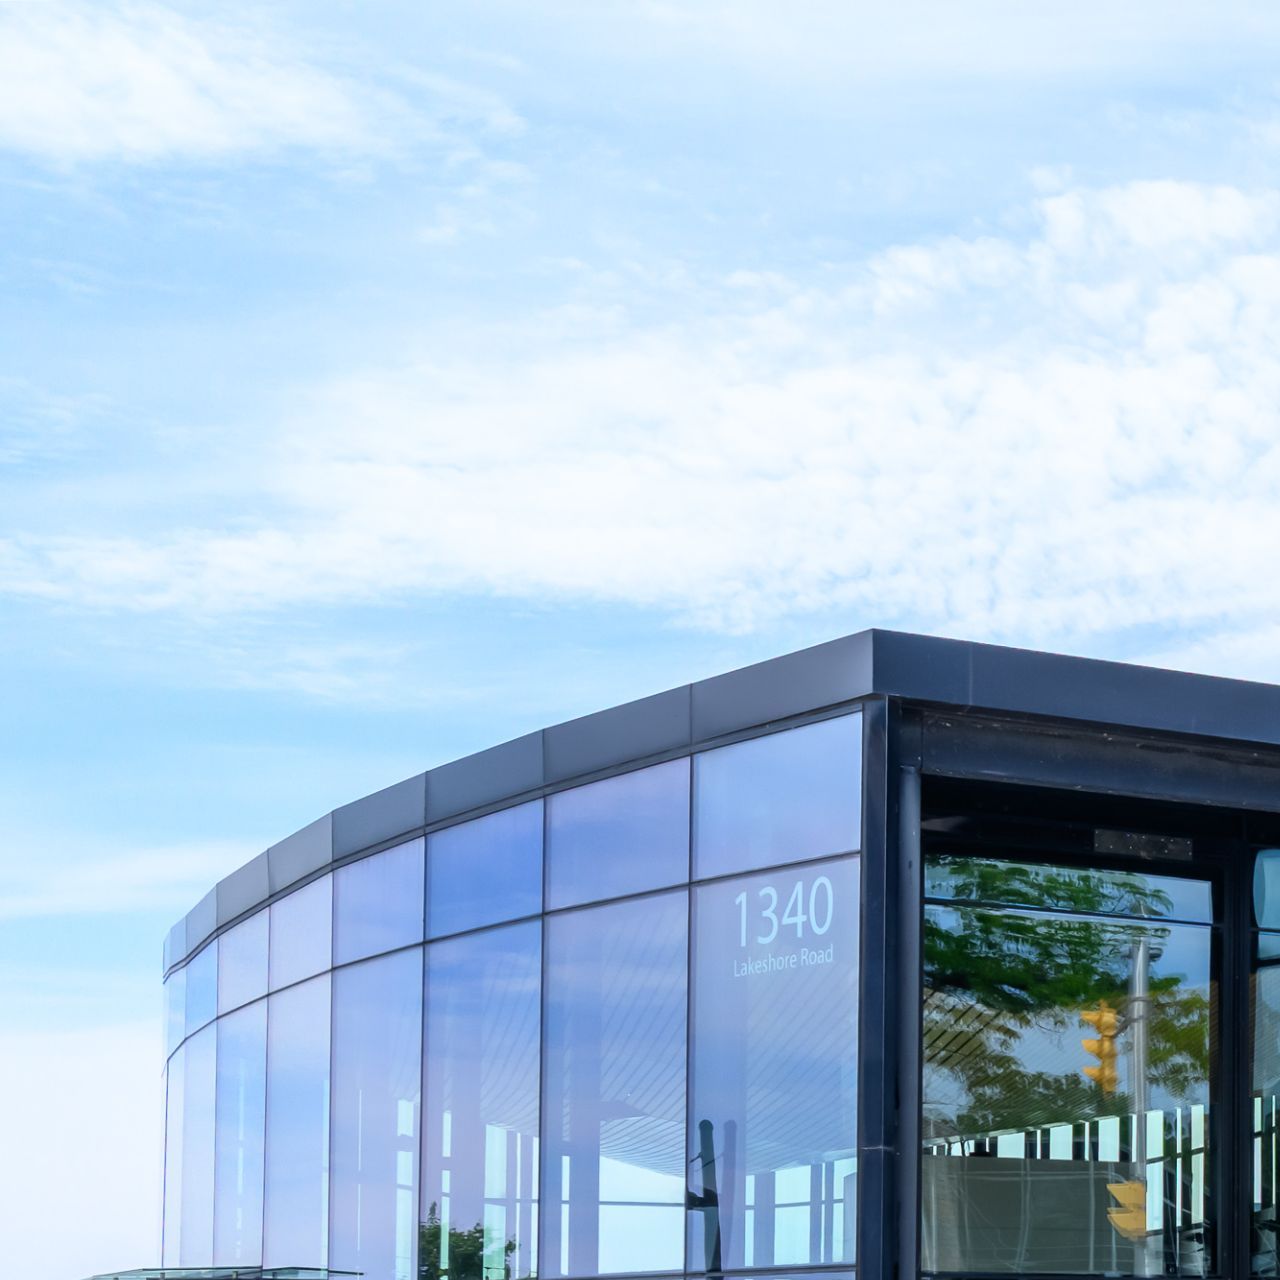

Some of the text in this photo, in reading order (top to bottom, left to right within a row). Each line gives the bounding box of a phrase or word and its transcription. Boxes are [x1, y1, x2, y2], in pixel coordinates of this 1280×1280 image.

[734, 876, 834, 947] 1340
[733, 943, 834, 978] Lakeshore Road
